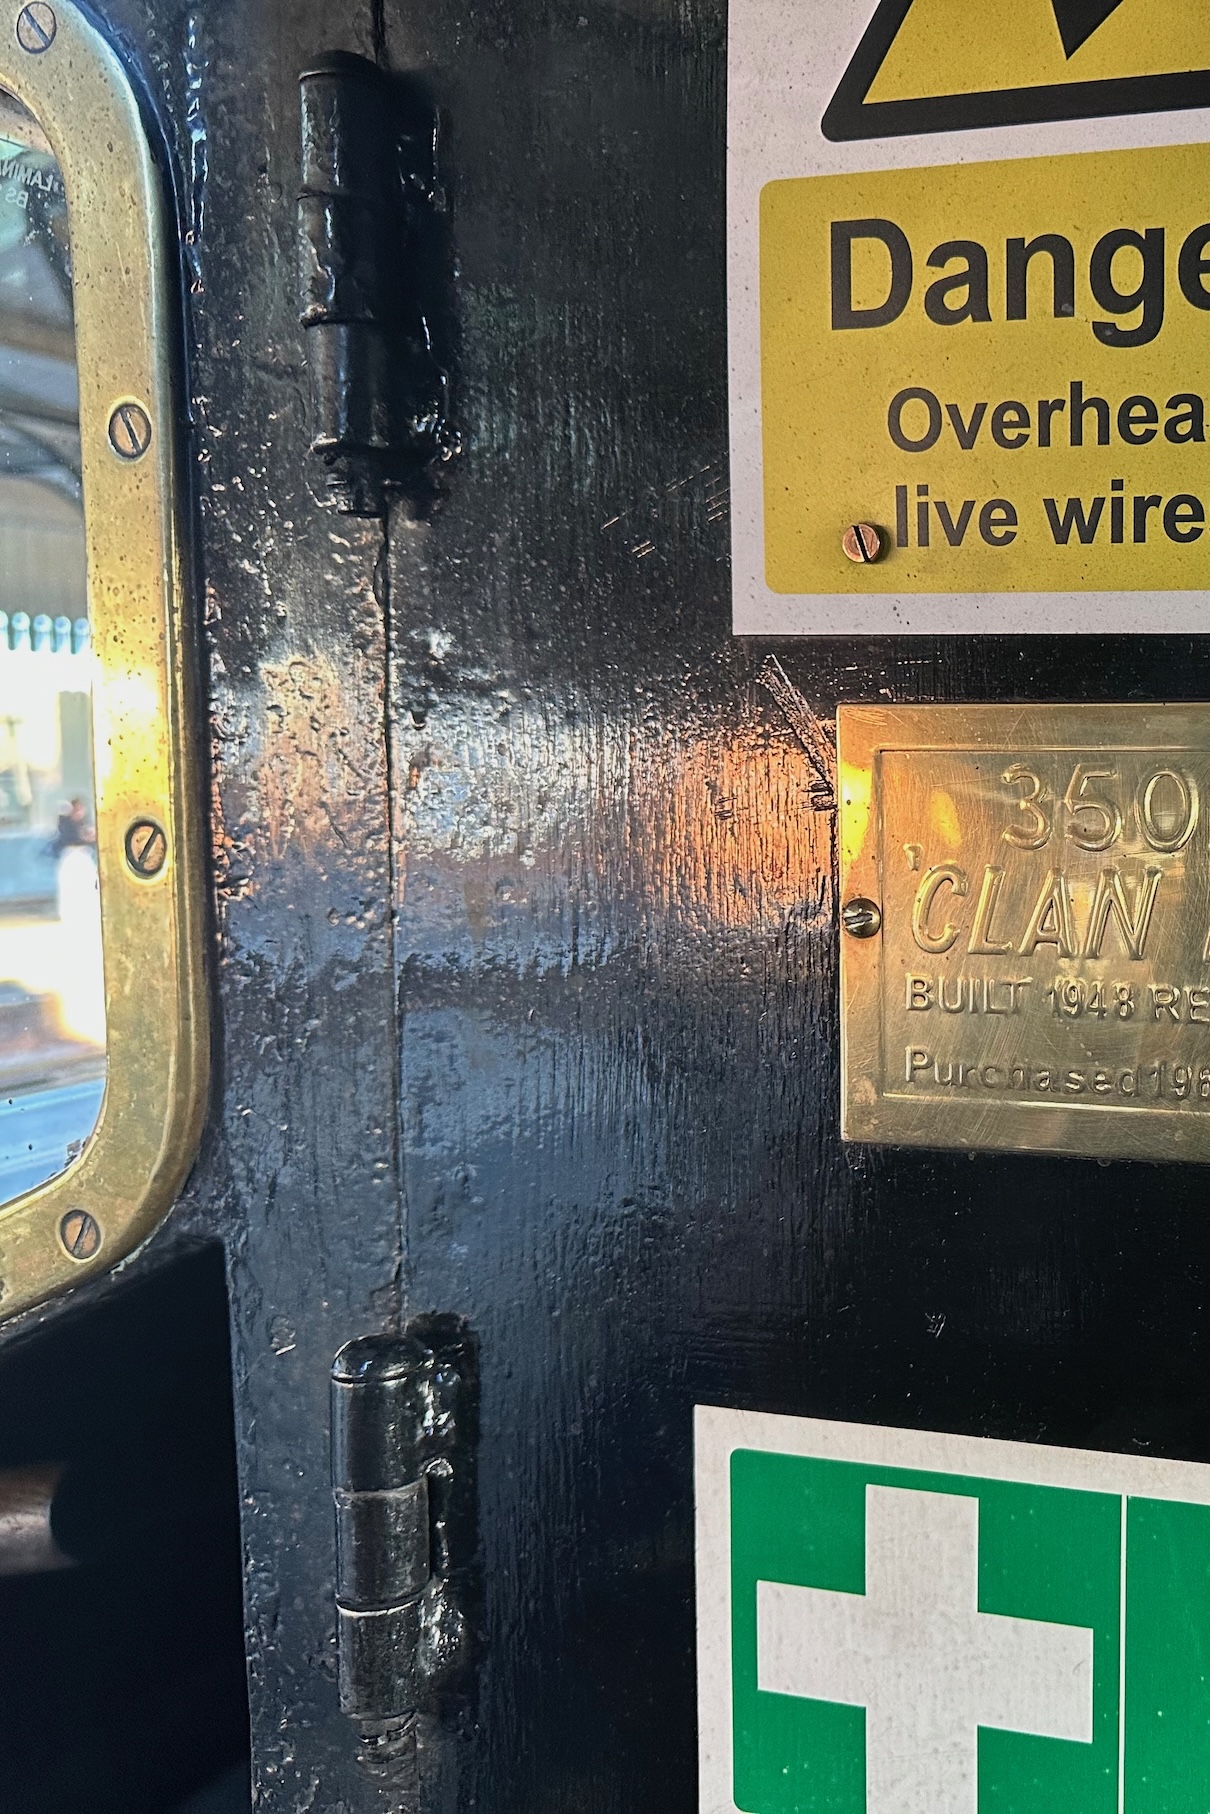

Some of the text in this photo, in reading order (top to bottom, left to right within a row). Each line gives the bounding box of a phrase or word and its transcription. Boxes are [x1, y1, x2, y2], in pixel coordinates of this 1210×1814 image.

[895, 484, 1018, 548] live
[905, 972, 1033, 1015] BUILT
[1048, 976, 1136, 1022] 1948
[905, 1045, 1140, 1098] Purchased
